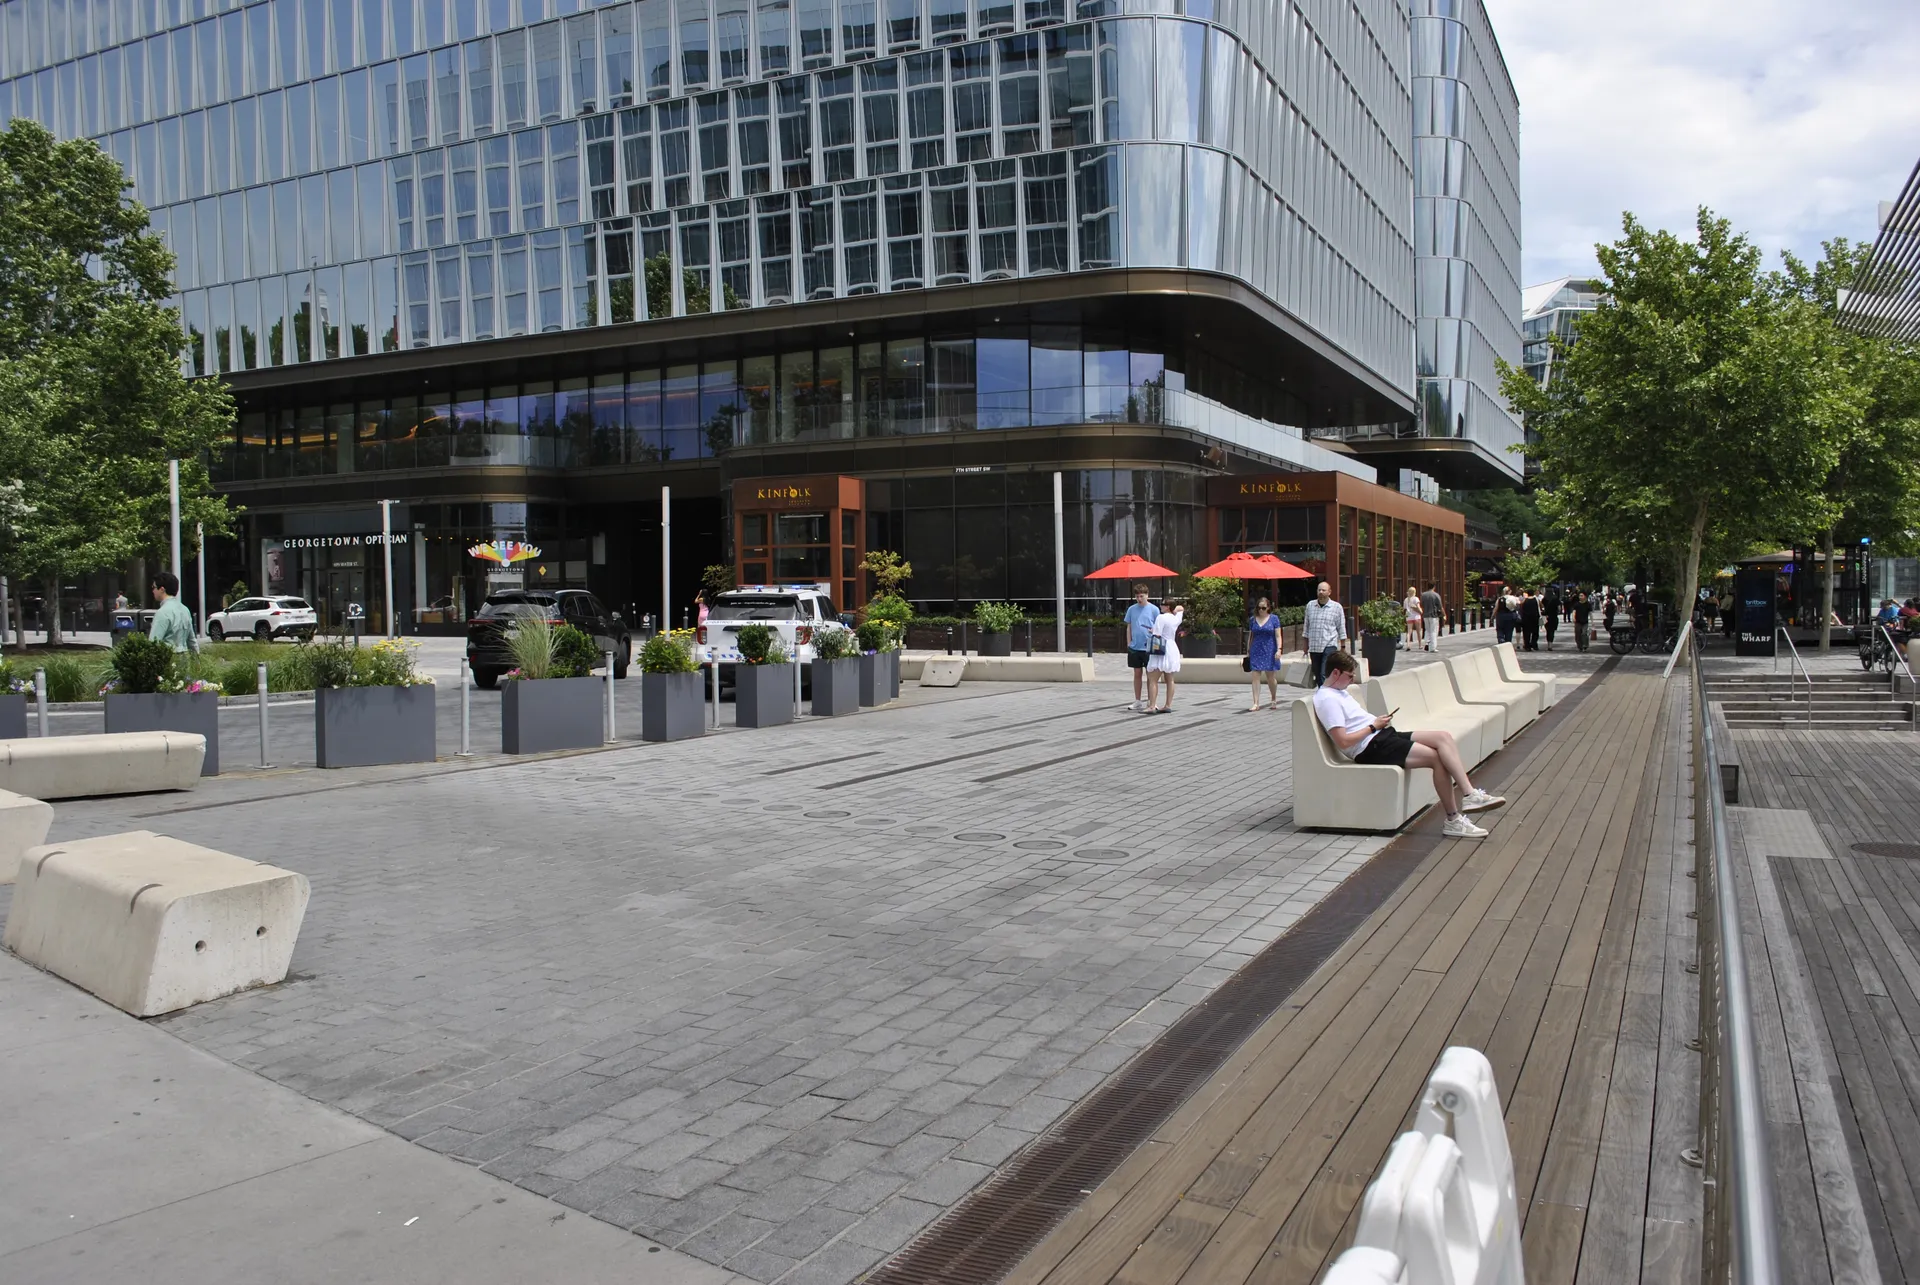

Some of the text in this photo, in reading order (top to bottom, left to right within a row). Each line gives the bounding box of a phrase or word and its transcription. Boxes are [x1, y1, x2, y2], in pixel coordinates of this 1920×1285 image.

[757, 485, 811, 499] KINFOLK
[1240, 481, 1302, 494] KINFOLK
[283, 536, 360, 549] GEORGETOWN
[467, 540, 542, 557] WE SEE YOU
